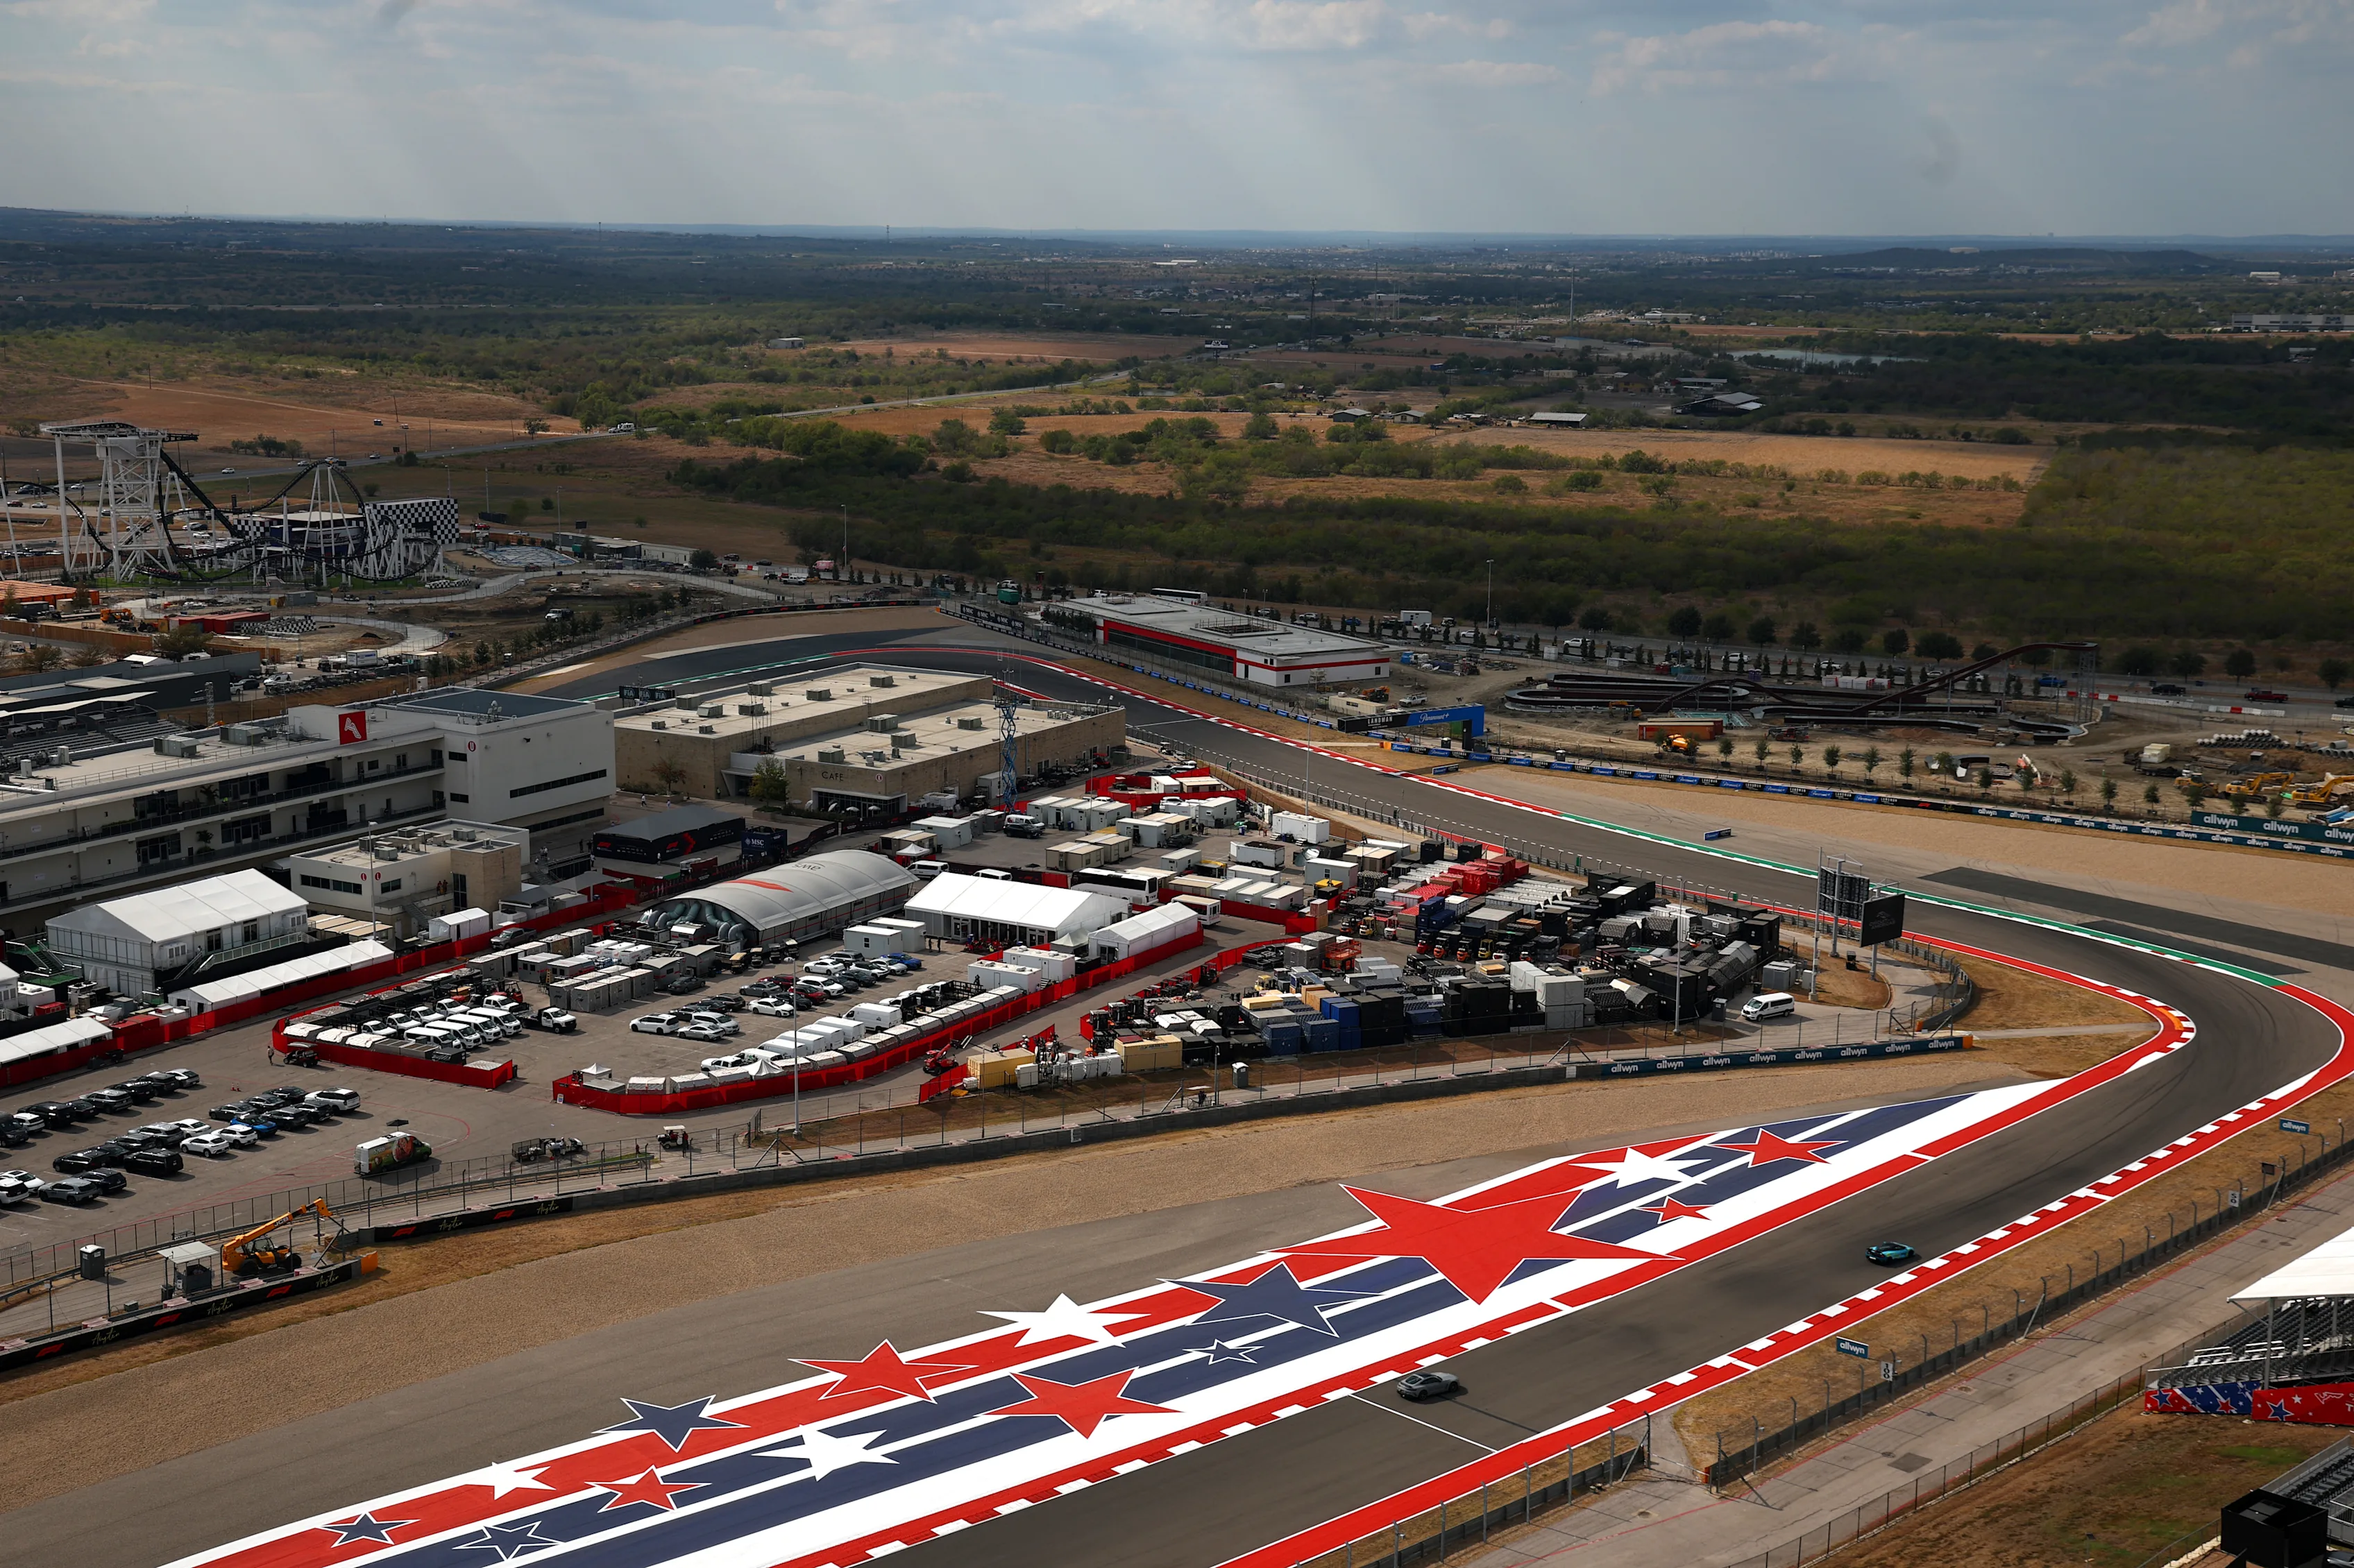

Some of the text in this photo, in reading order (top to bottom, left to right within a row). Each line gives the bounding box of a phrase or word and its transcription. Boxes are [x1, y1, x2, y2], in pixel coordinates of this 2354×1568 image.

[1367, 716, 1393, 724] LANDMAN
[822, 772, 844, 781] CAFE
[2010, 812, 2029, 820] allwyn
[2042, 815, 2062, 824] allwyn
[2203, 813, 2238, 828] allwyn
[2074, 819, 2094, 828] allwyn
[2107, 823, 2128, 833] allwyn
[2262, 820, 2299, 835] allwyn
[2142, 827, 2162, 836] allwyn
[2176, 830, 2197, 840] allwyn
[2211, 834, 2233, 844] allwyn
[2247, 838, 2269, 848] allwyn
[2283, 842, 2305, 852] allwyn
[2320, 847, 2343, 857] allwyn
[1885, 1043, 1911, 1053] allwyn
[1928, 1039, 1954, 1049] allwyn
[1795, 1050, 1822, 1060] allwyn
[1840, 1047, 1867, 1057] allwyn
[1703, 1056, 1730, 1067] allwyn
[1749, 1053, 1777, 1064] allwyn
[1611, 1064, 1638, 1074] allwyn
[1657, 1059, 1684, 1070] allwyn
[2282, 1122, 2306, 1132] allwyn
[2230, 1193, 2237, 1203] 50
[536, 1200, 559, 1214] Austin
[274, 1217, 289, 1227] JCB
[439, 1217, 463, 1231] Austin
[315, 1270, 339, 1288] Austin
[208, 1298, 233, 1315] Austin
[92, 1327, 120, 1345] Austin
[1839, 1342, 1865, 1354] allwyn
